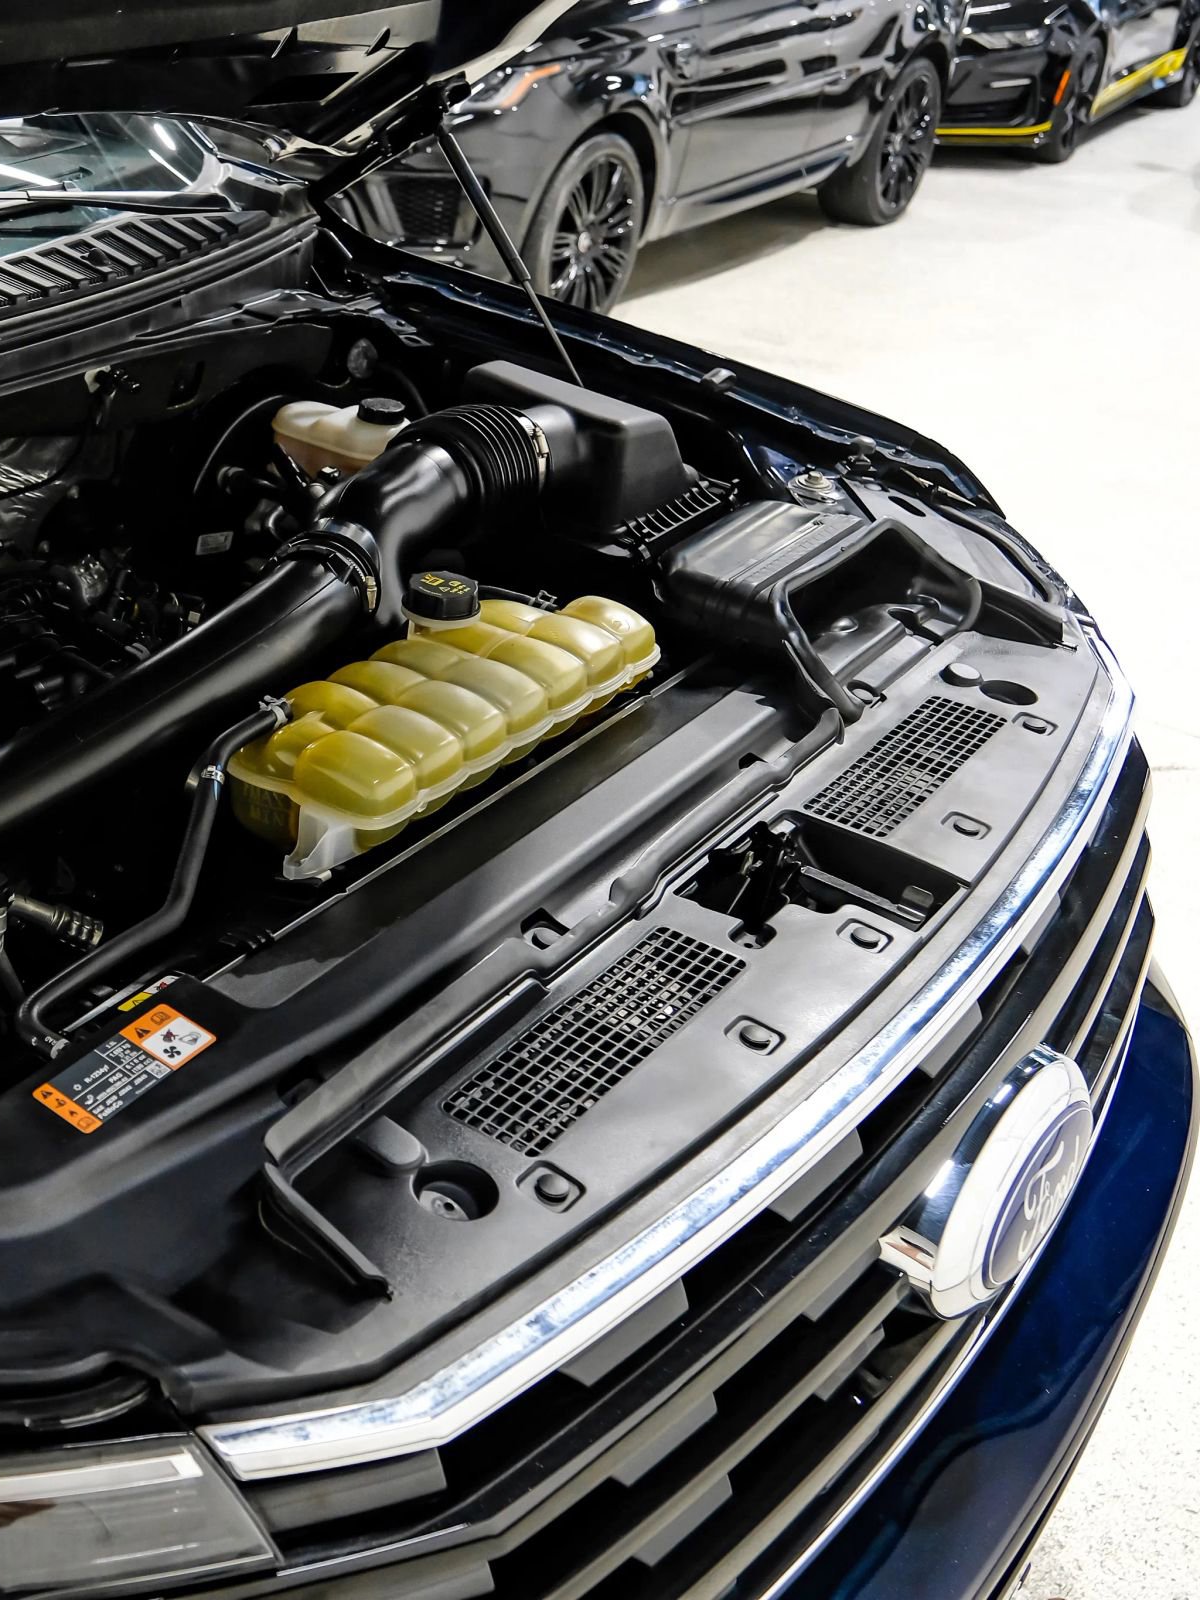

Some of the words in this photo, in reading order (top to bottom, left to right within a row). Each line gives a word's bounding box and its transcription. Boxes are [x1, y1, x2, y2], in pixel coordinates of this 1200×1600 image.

[83, 1064, 110, 1084] R-1234yf
[108, 1072, 123, 1084] PAG
[97, 1100, 123, 1120] FoMoCo
[1017, 1133, 1080, 1263] Ford
